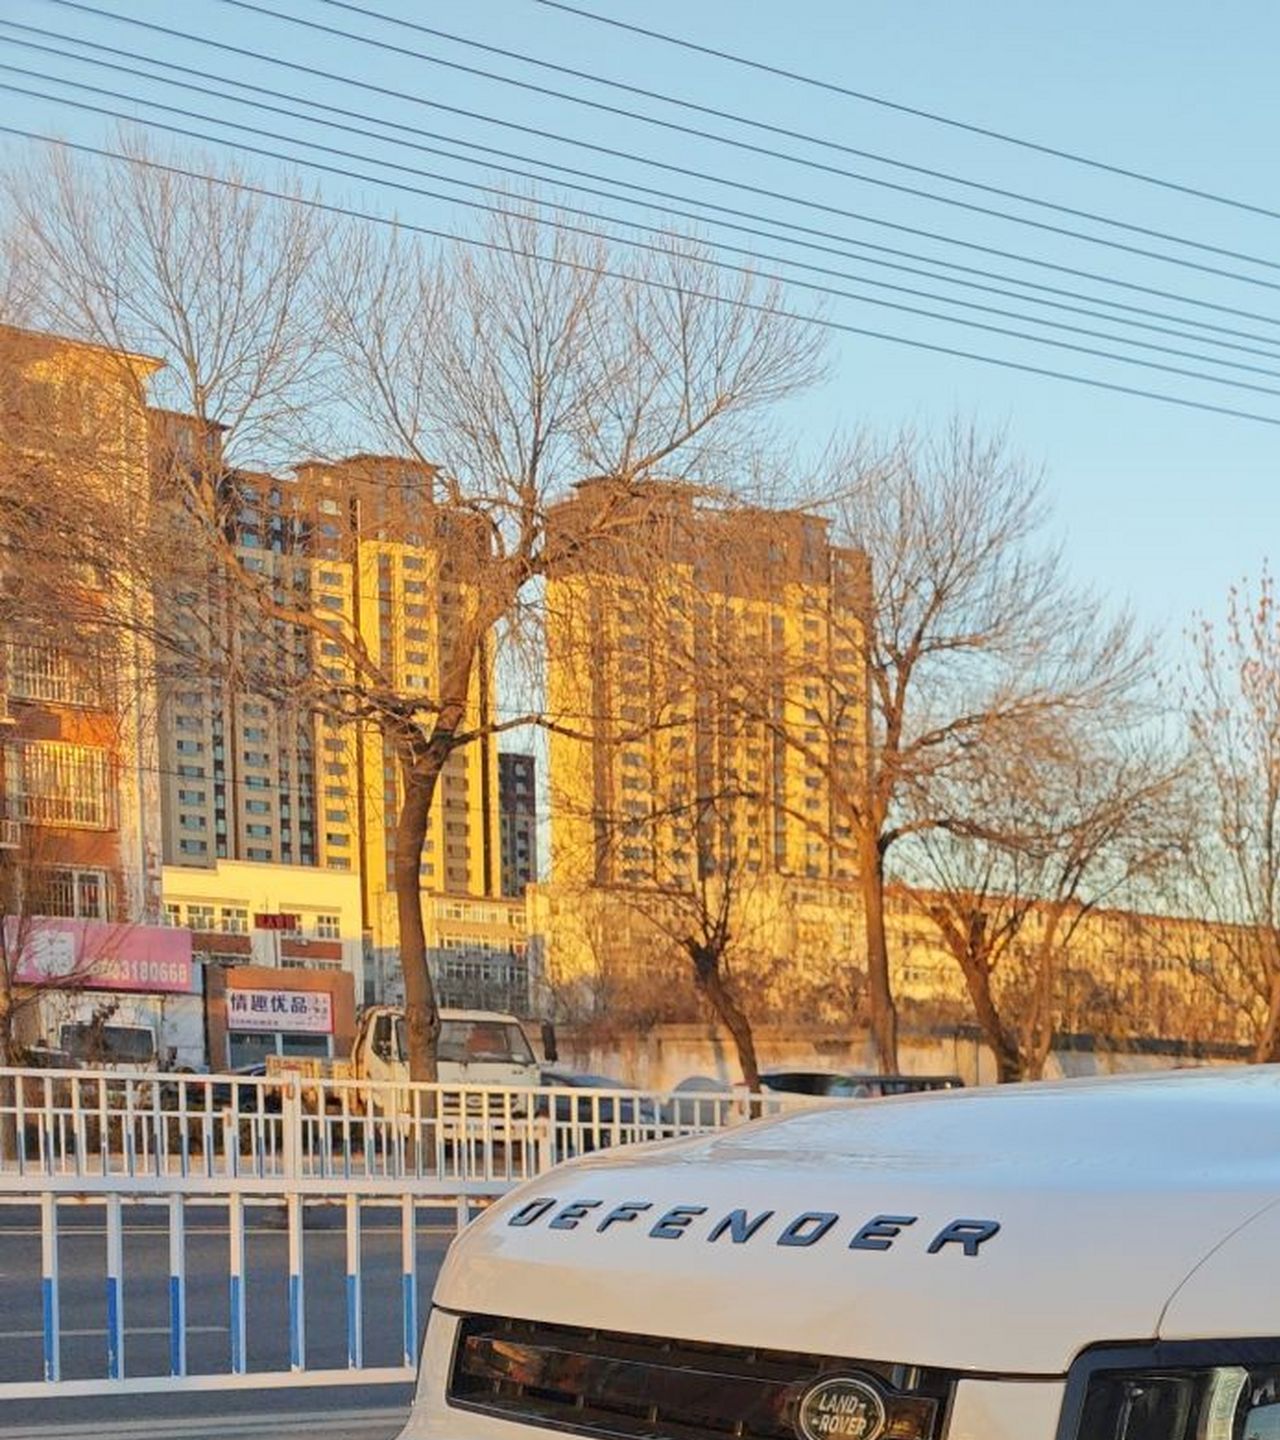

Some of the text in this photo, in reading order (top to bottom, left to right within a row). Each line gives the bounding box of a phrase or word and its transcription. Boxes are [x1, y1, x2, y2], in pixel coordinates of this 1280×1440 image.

[507, 1197, 1001, 1257] DEFENDER
[819, 1392, 859, 1414] LAND
[819, 1415, 867, 1436] ROVER
